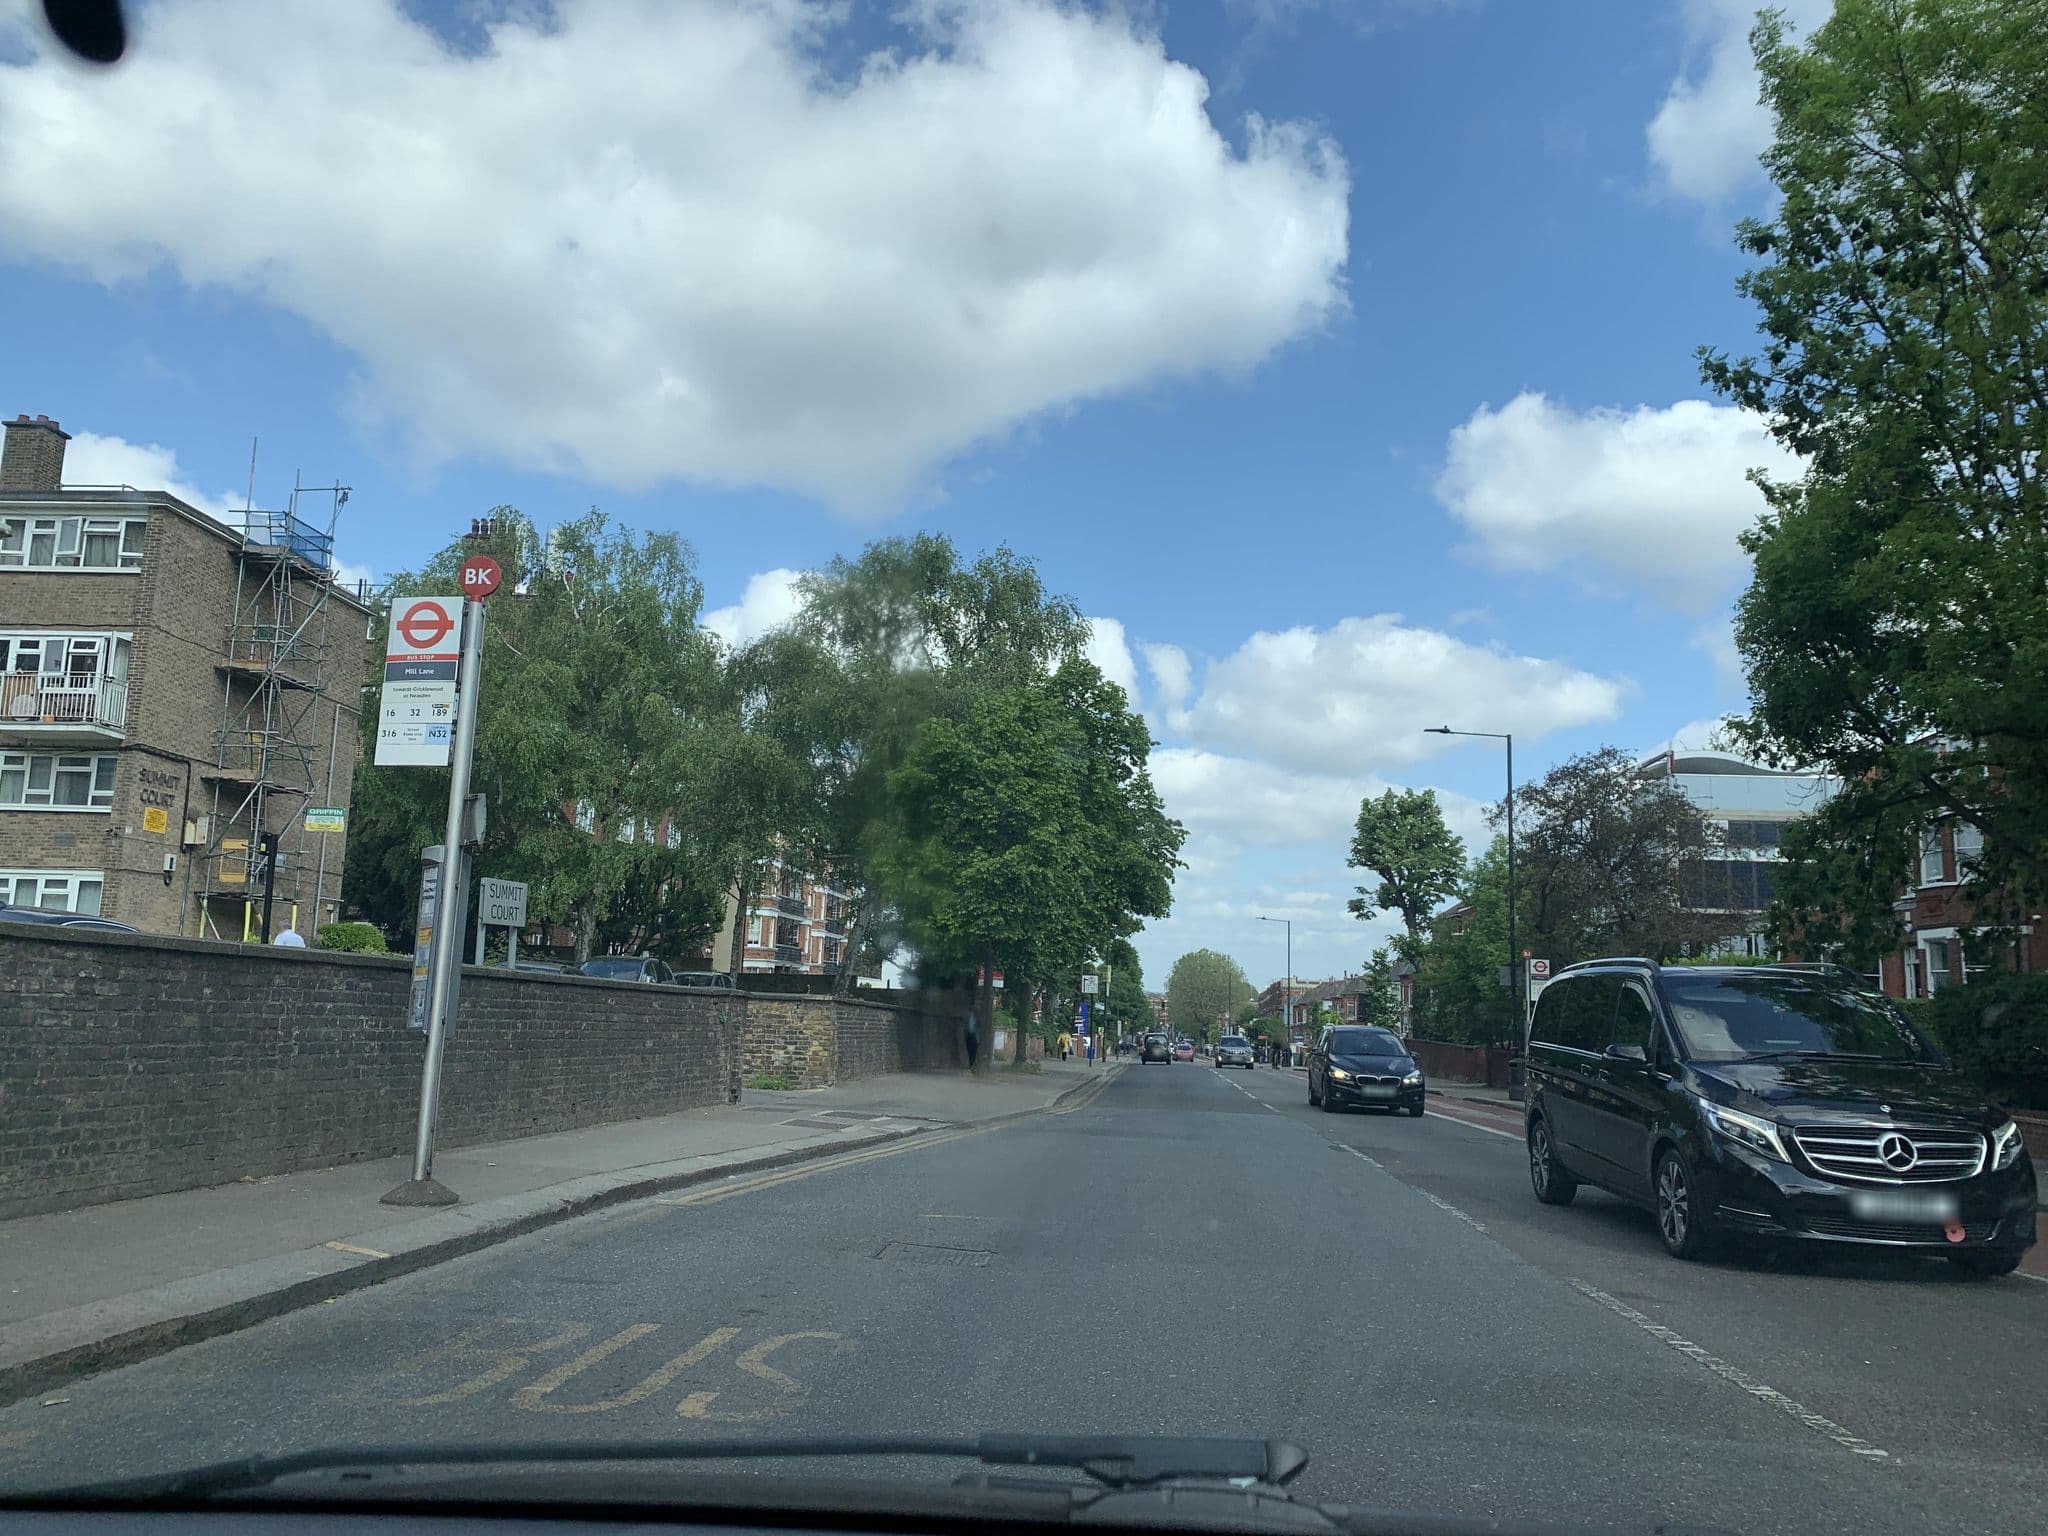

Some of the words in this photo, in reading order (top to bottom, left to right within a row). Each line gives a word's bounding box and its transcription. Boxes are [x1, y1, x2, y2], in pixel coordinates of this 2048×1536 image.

[465, 568, 492, 585] BK
[419, 667, 435, 675] Lane
[386, 709, 396, 717] 16
[410, 708, 420, 717] 32
[432, 708, 448, 717] 189
[381, 730, 397, 738] 316
[428, 730, 447, 738] N32
[139, 768, 181, 790] SUMMIT
[139, 788, 176, 808] COURT
[489, 883, 523, 903] SUMMIT
[490, 904, 520, 922] COURT
